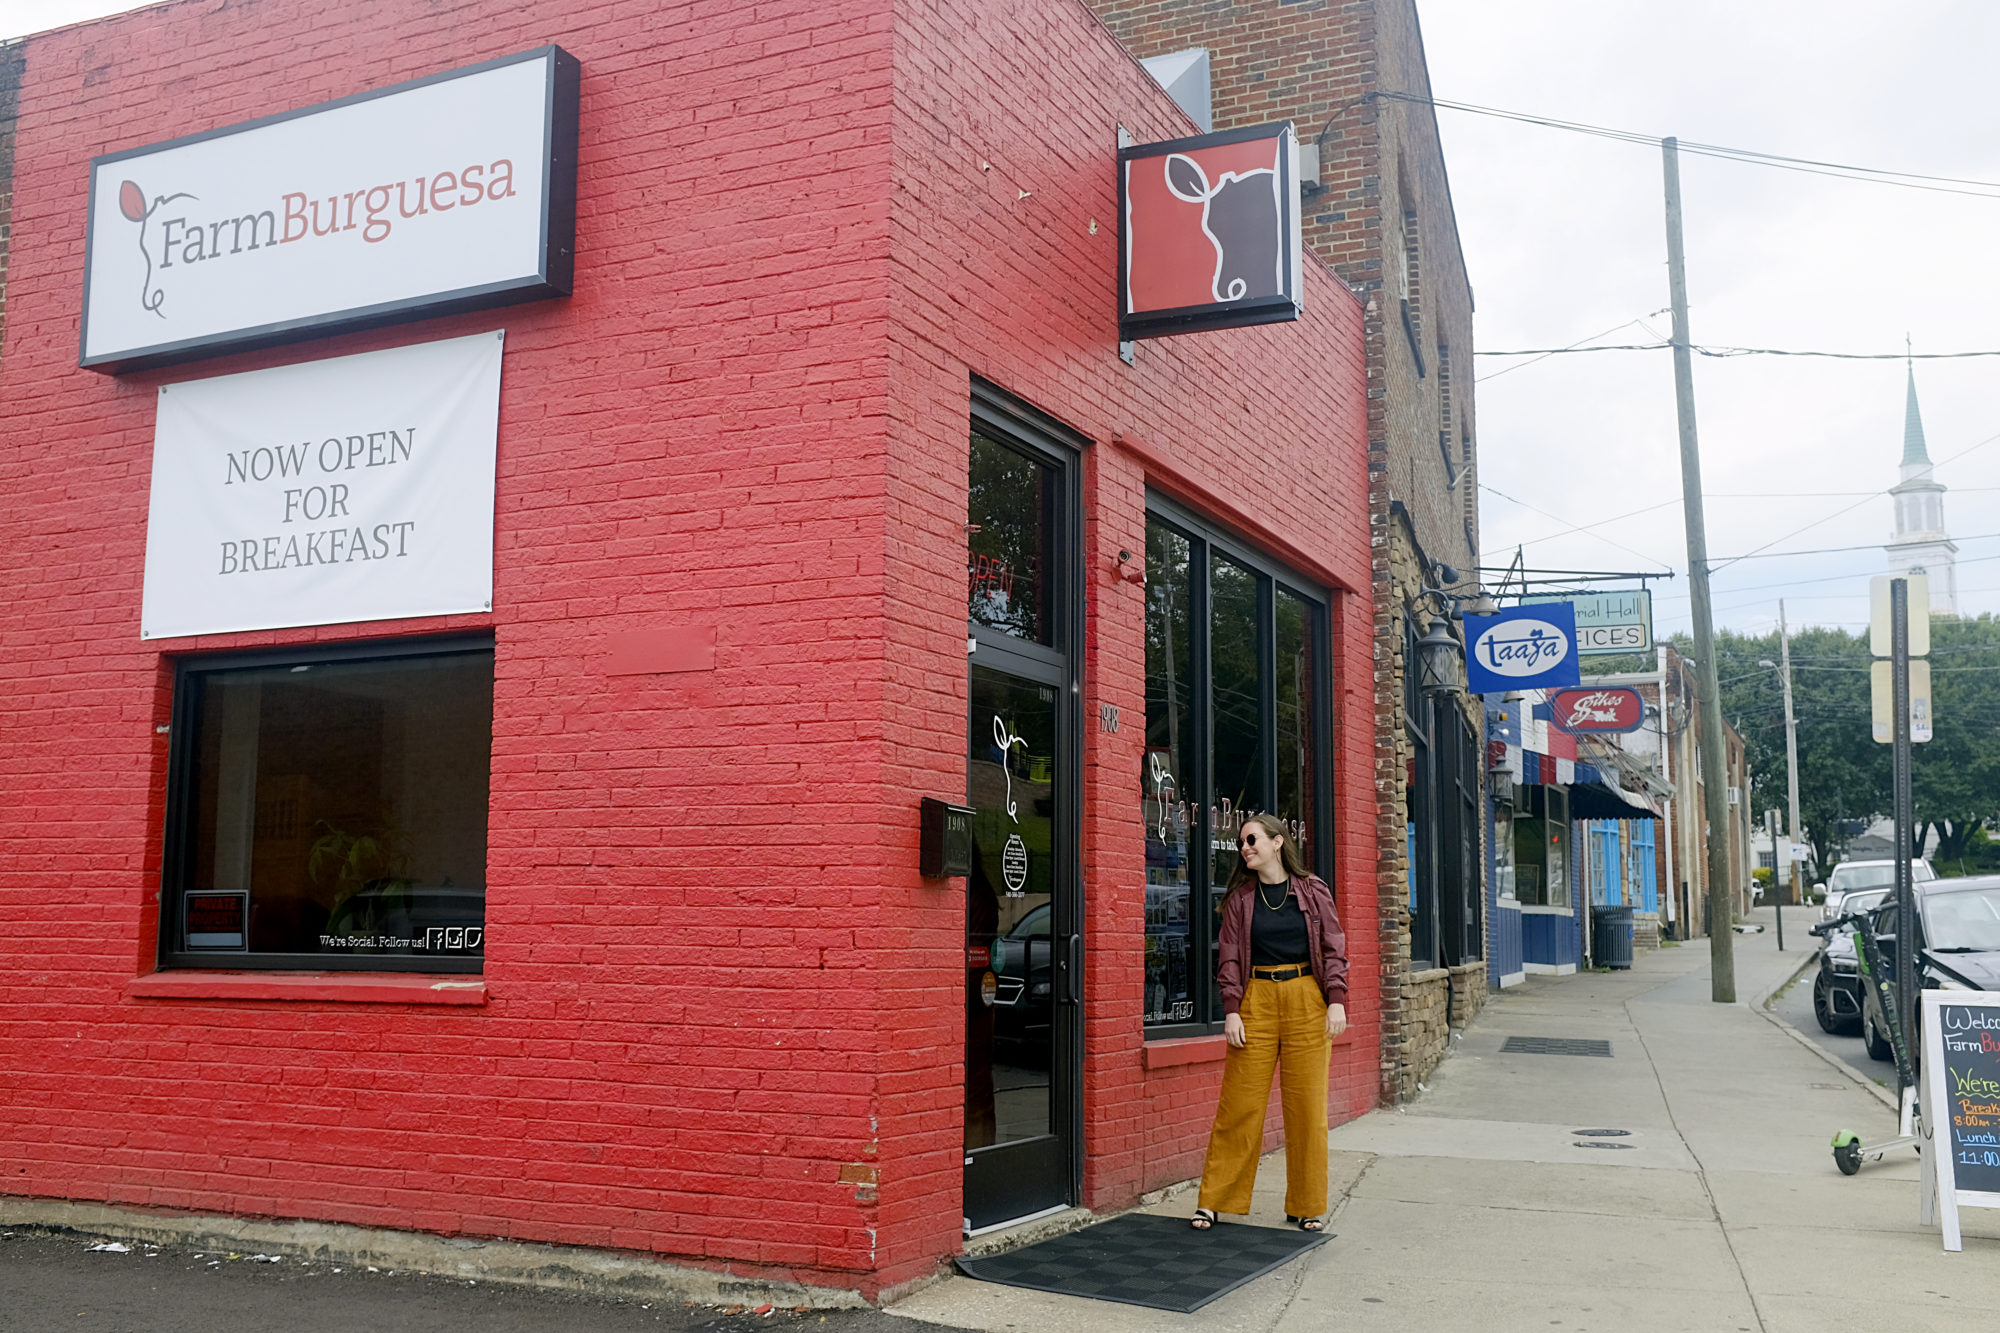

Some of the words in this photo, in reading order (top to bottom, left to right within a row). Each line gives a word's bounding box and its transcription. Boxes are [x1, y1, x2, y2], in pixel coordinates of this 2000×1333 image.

[159, 158, 517, 269] FarmBurguesa
[225, 442, 311, 485] NOW
[318, 428, 416, 473] OPEN
[282, 483, 350, 524] FOR
[218, 521, 415, 576] BREAKFAST
[1606, 597, 1640, 619] Hall
[948, 815, 967, 832] 1908
[193, 897, 238, 911] PRIVATE
[188, 911, 241, 926] PROPERTY
[319, 935, 346, 947] We're
[347, 935, 377, 947] Social.
[378, 936, 410, 948] Follow
[411, 936, 426, 948] us!
[1949, 1066, 2000, 1093] We're
[1955, 1128, 1997, 1144] Lunch
